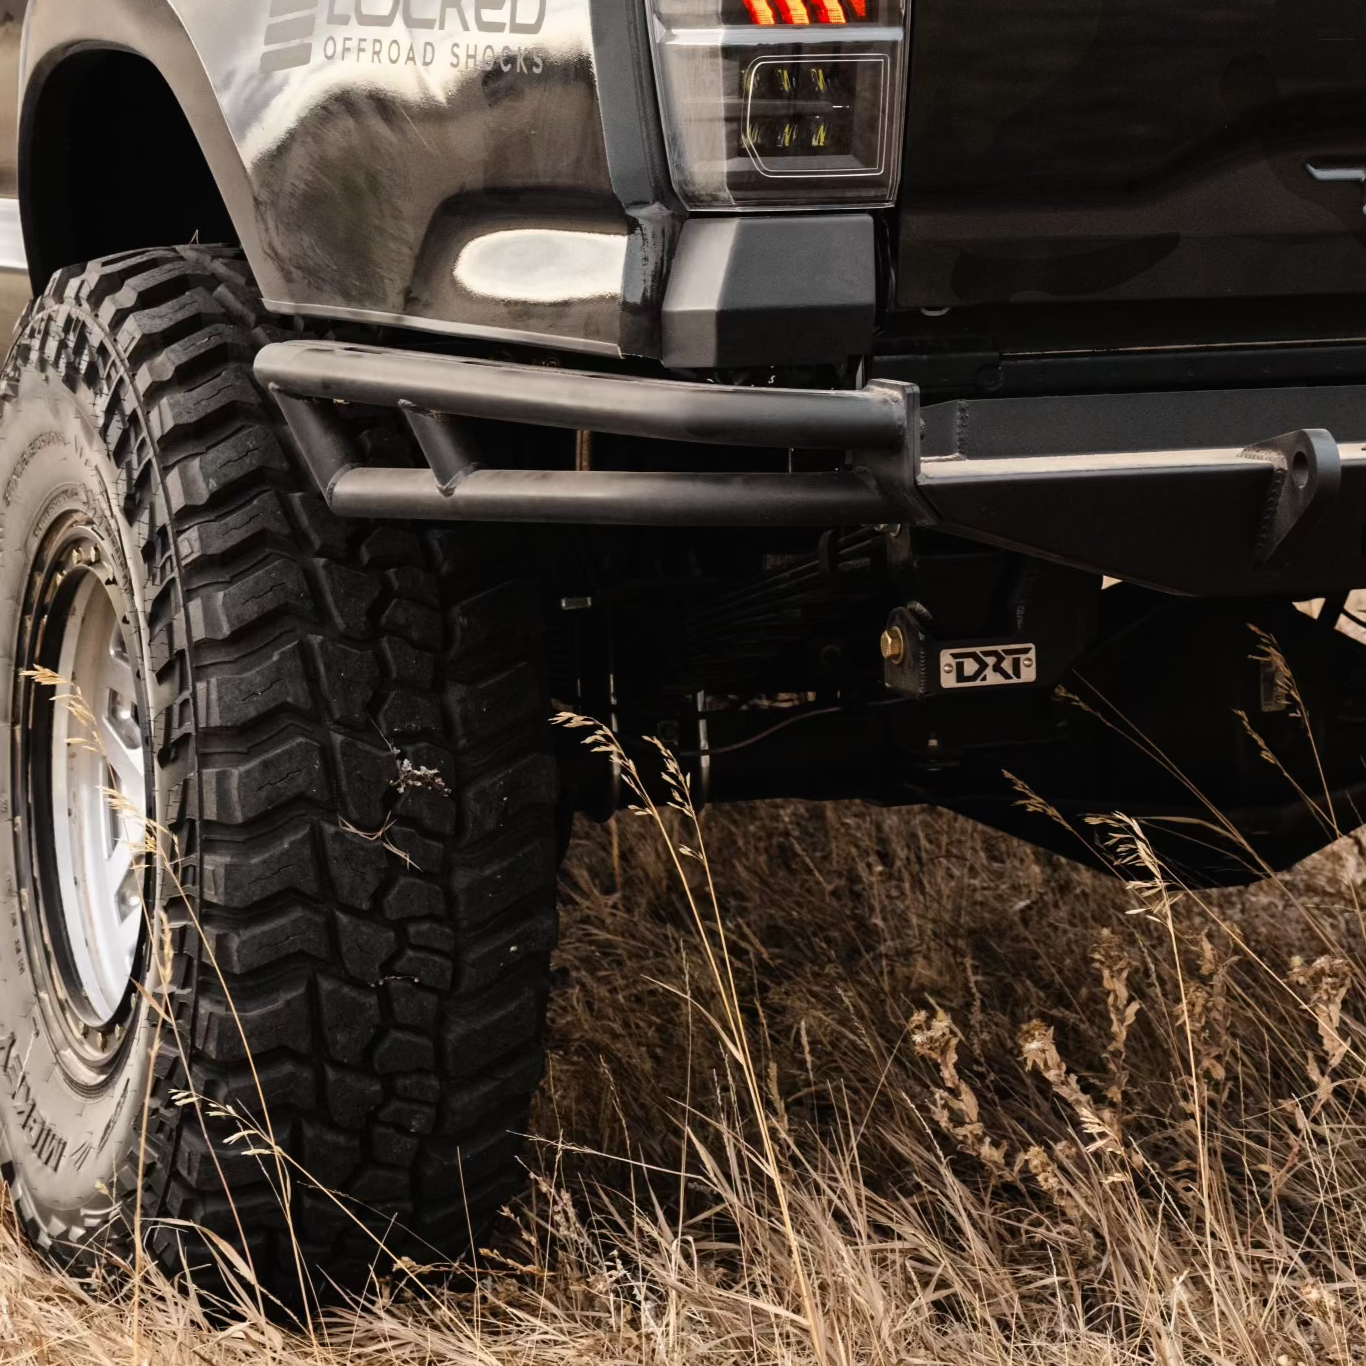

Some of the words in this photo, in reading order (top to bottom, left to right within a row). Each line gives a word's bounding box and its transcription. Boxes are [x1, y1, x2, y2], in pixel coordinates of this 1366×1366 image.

[323, 35, 436, 67] OFFROAD
[449, 41, 543, 74] SHOCKS
[949, 647, 1034, 684] DRT
